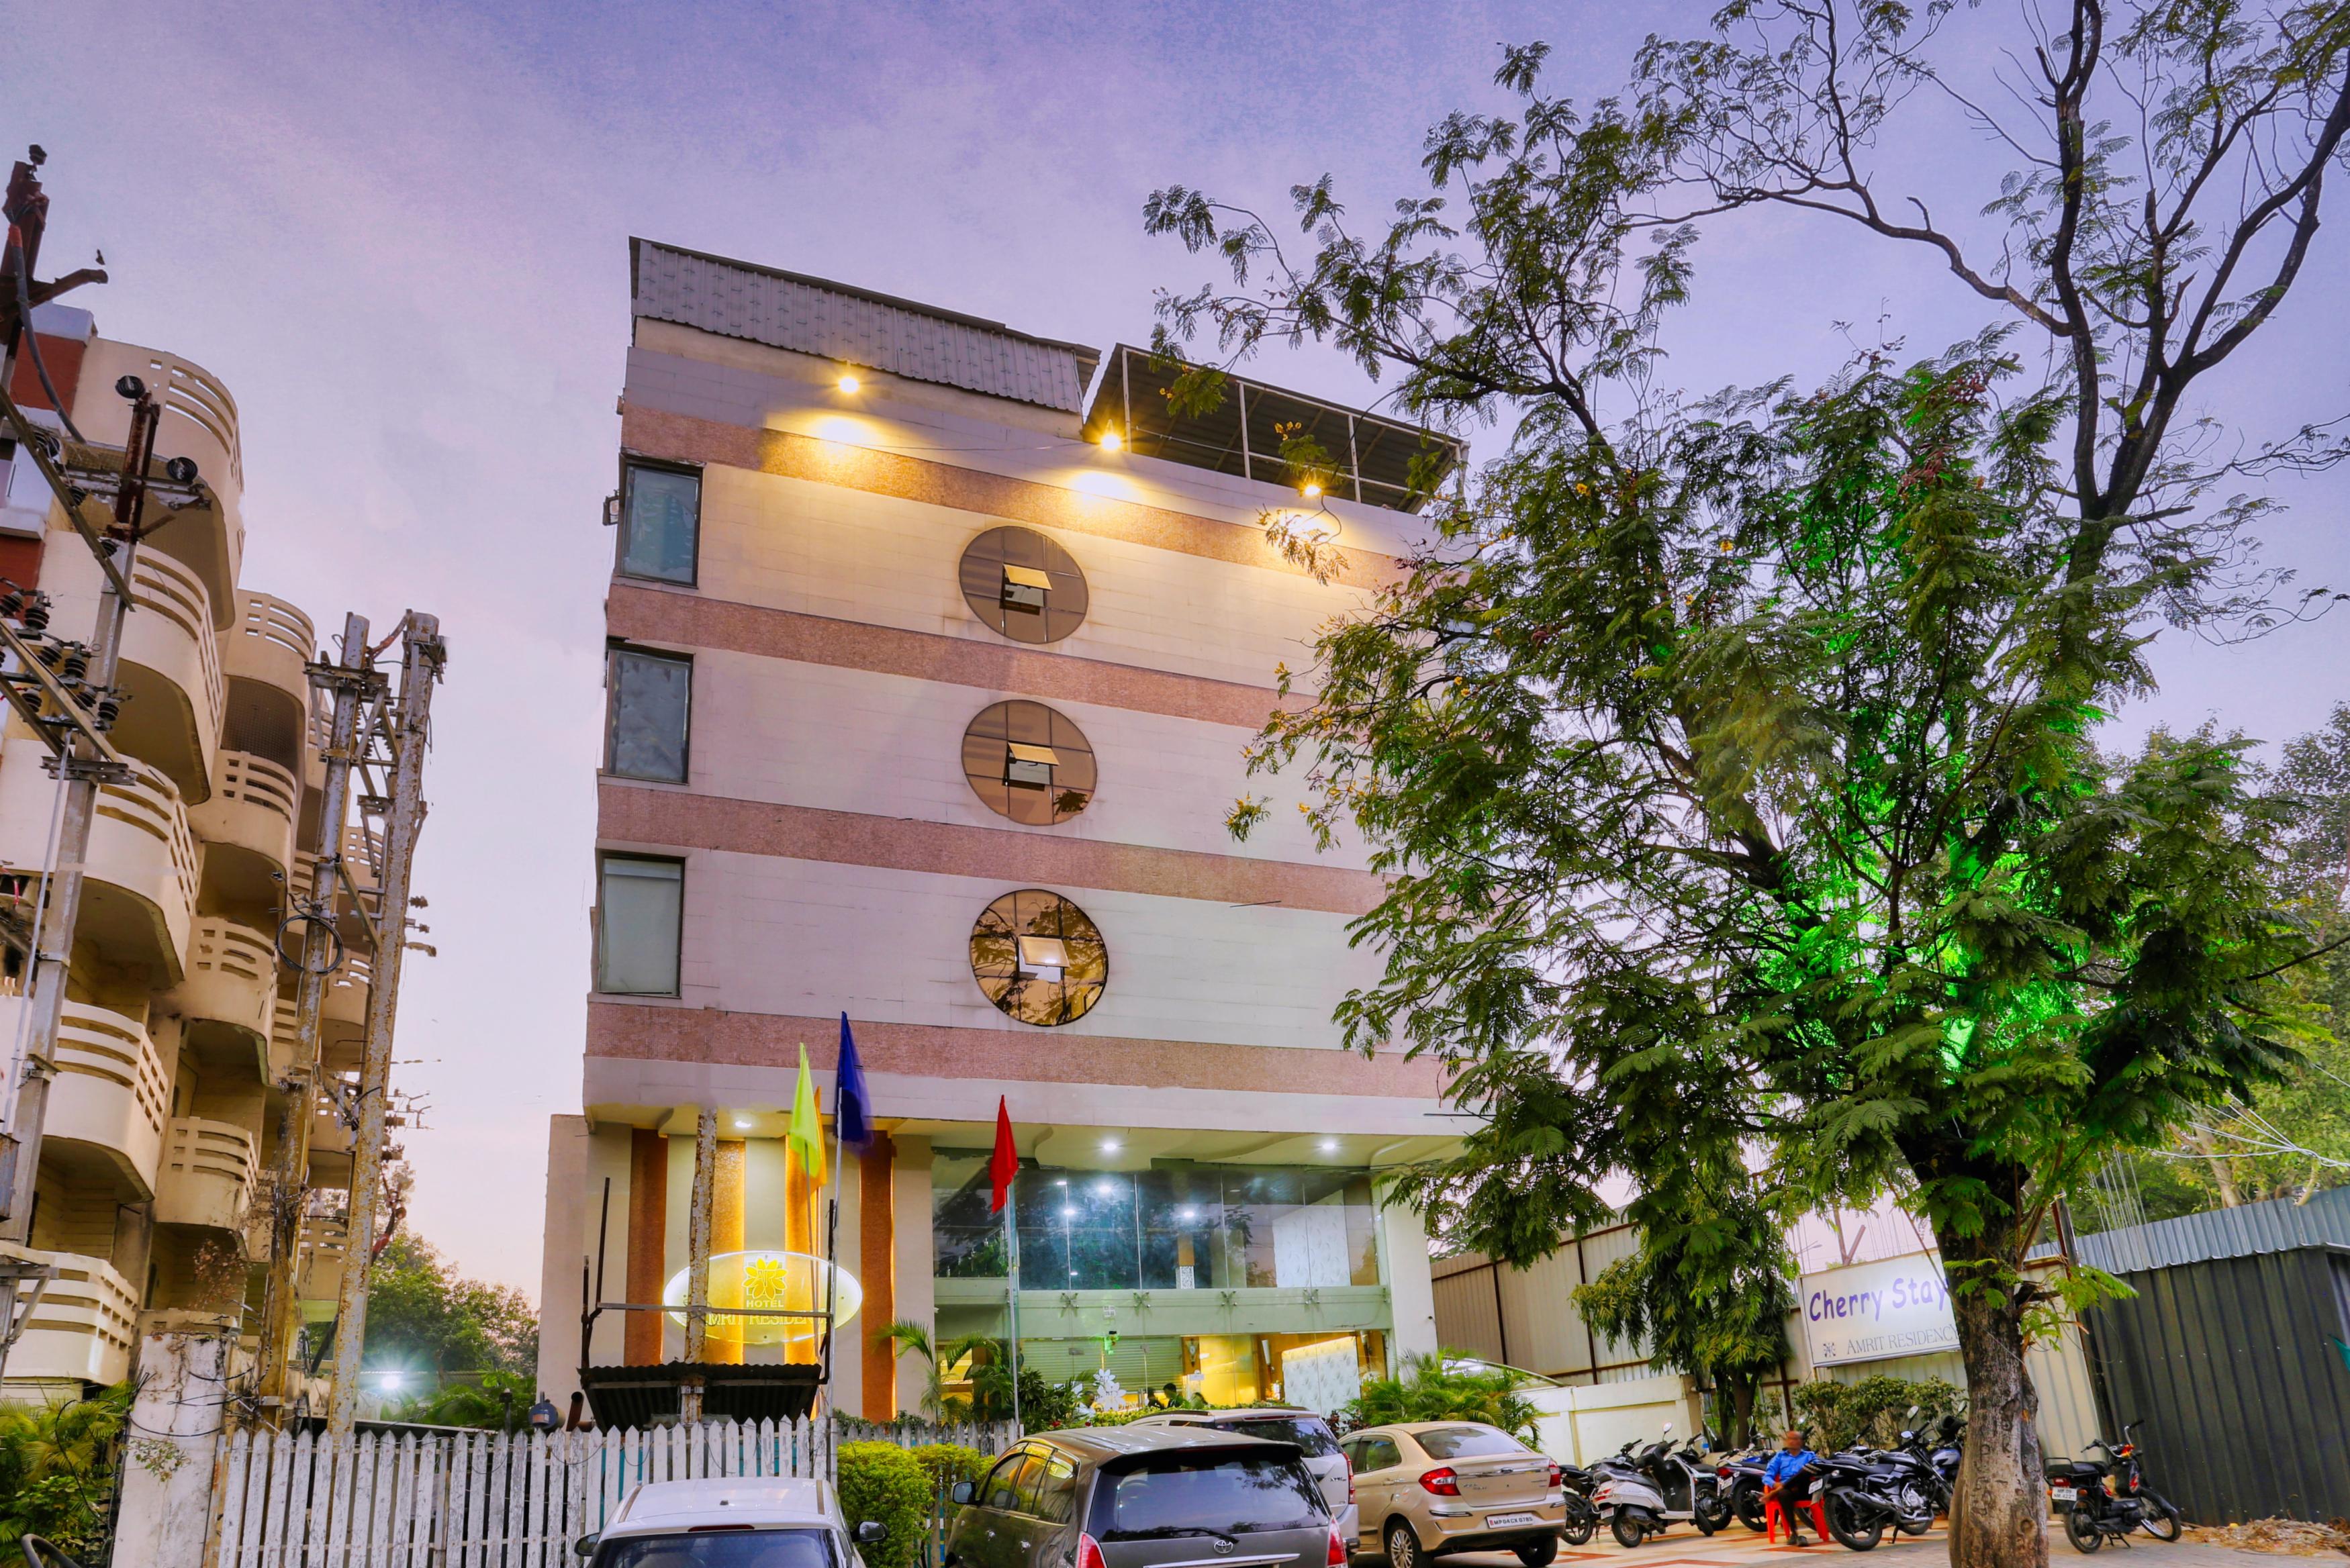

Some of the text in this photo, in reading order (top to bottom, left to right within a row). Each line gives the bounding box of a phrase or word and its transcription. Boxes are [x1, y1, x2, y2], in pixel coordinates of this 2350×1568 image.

[746, 1300, 784, 1308] HOTEL
[1809, 1277, 1949, 1322] Cherry Stay
[705, 1310, 743, 1325] MRIT
[1847, 1324, 1959, 1355] AMRIT RESIDENCY
